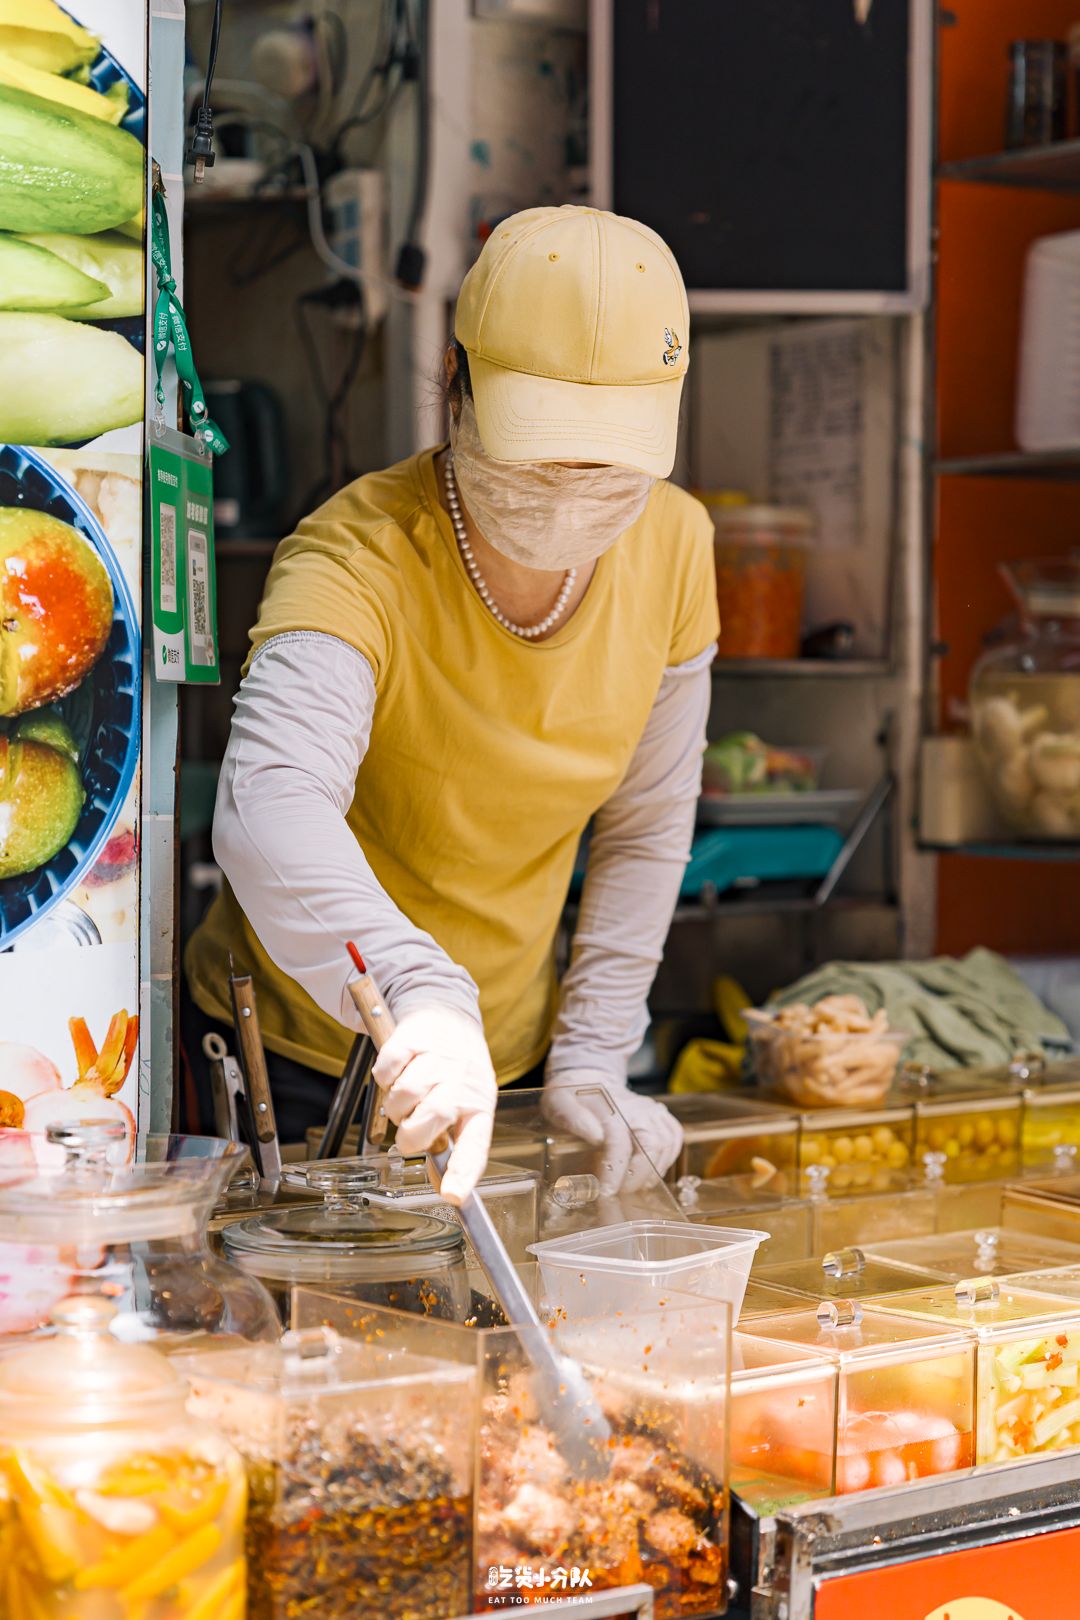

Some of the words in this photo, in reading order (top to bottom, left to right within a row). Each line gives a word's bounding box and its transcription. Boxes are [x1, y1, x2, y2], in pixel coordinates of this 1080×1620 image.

[158, 312, 168, 340] 微信支付
[171, 315, 188, 351] 微信支付
